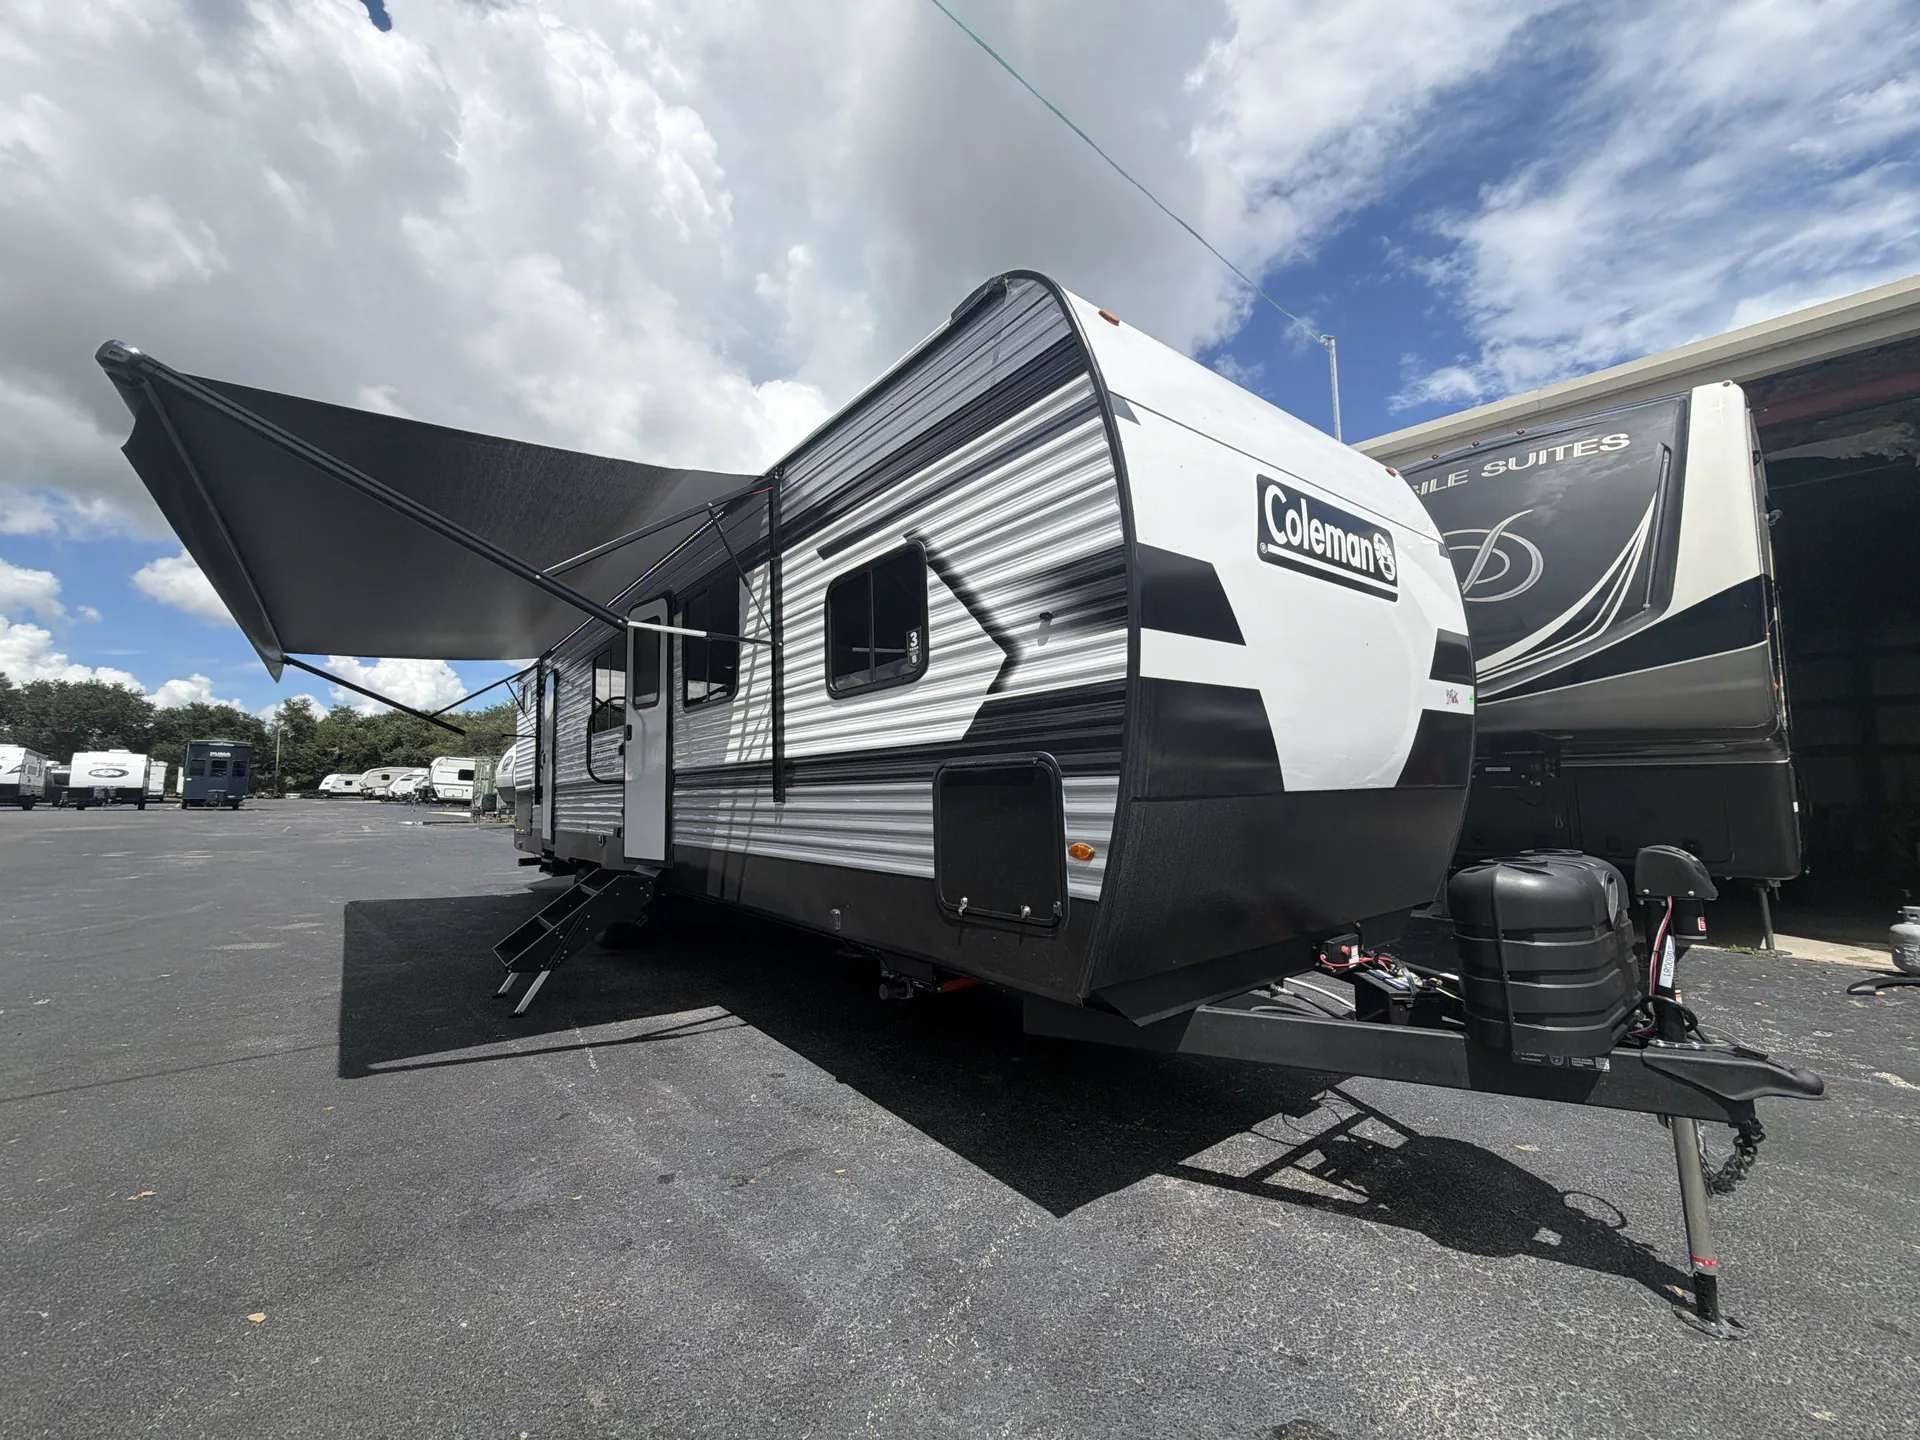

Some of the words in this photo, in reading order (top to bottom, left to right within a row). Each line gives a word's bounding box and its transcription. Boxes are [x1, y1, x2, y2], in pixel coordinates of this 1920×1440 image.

[1481, 433, 1631, 477] SUITES
[1265, 484, 1375, 573] Coleman
[910, 631, 918, 647] 3
